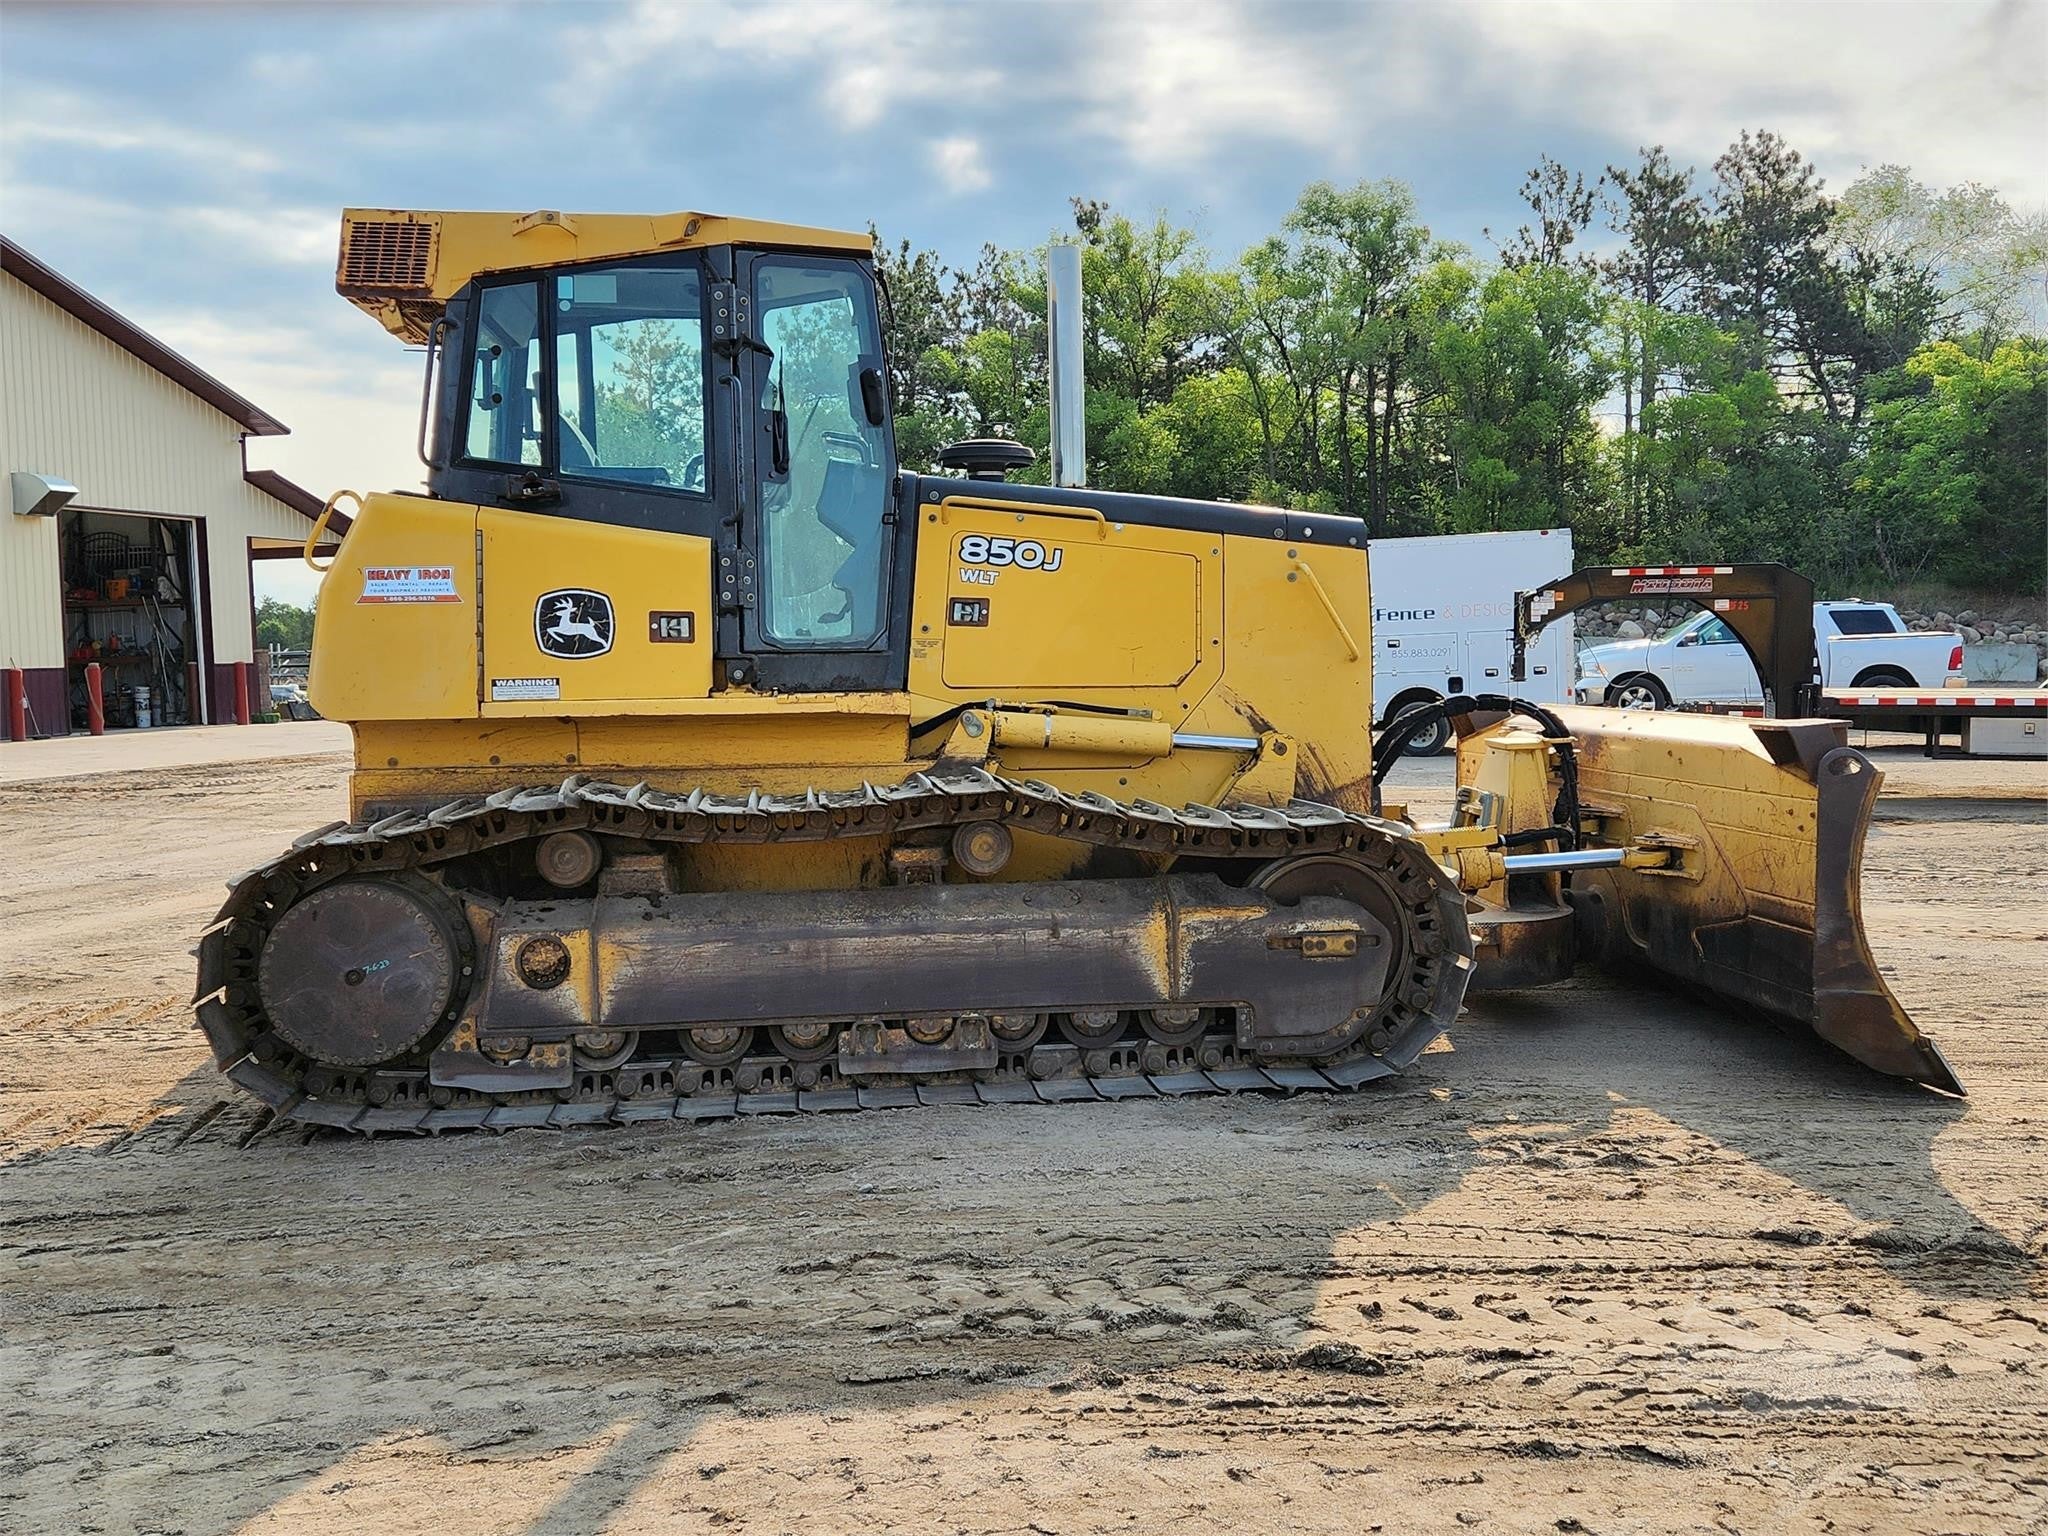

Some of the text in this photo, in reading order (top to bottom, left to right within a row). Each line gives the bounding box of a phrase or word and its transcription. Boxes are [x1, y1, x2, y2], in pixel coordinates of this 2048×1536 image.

[958, 535, 1063, 572] 850J
[367, 569, 451, 580] HEAVY IRON
[959, 567, 1000, 585] WLT
[1376, 608, 1435, 621] Fence
[1461, 602, 1512, 618] DESIG
[1391, 647, 1452, 659] 855.883.0291
[495, 679, 557, 687] WARNING!
